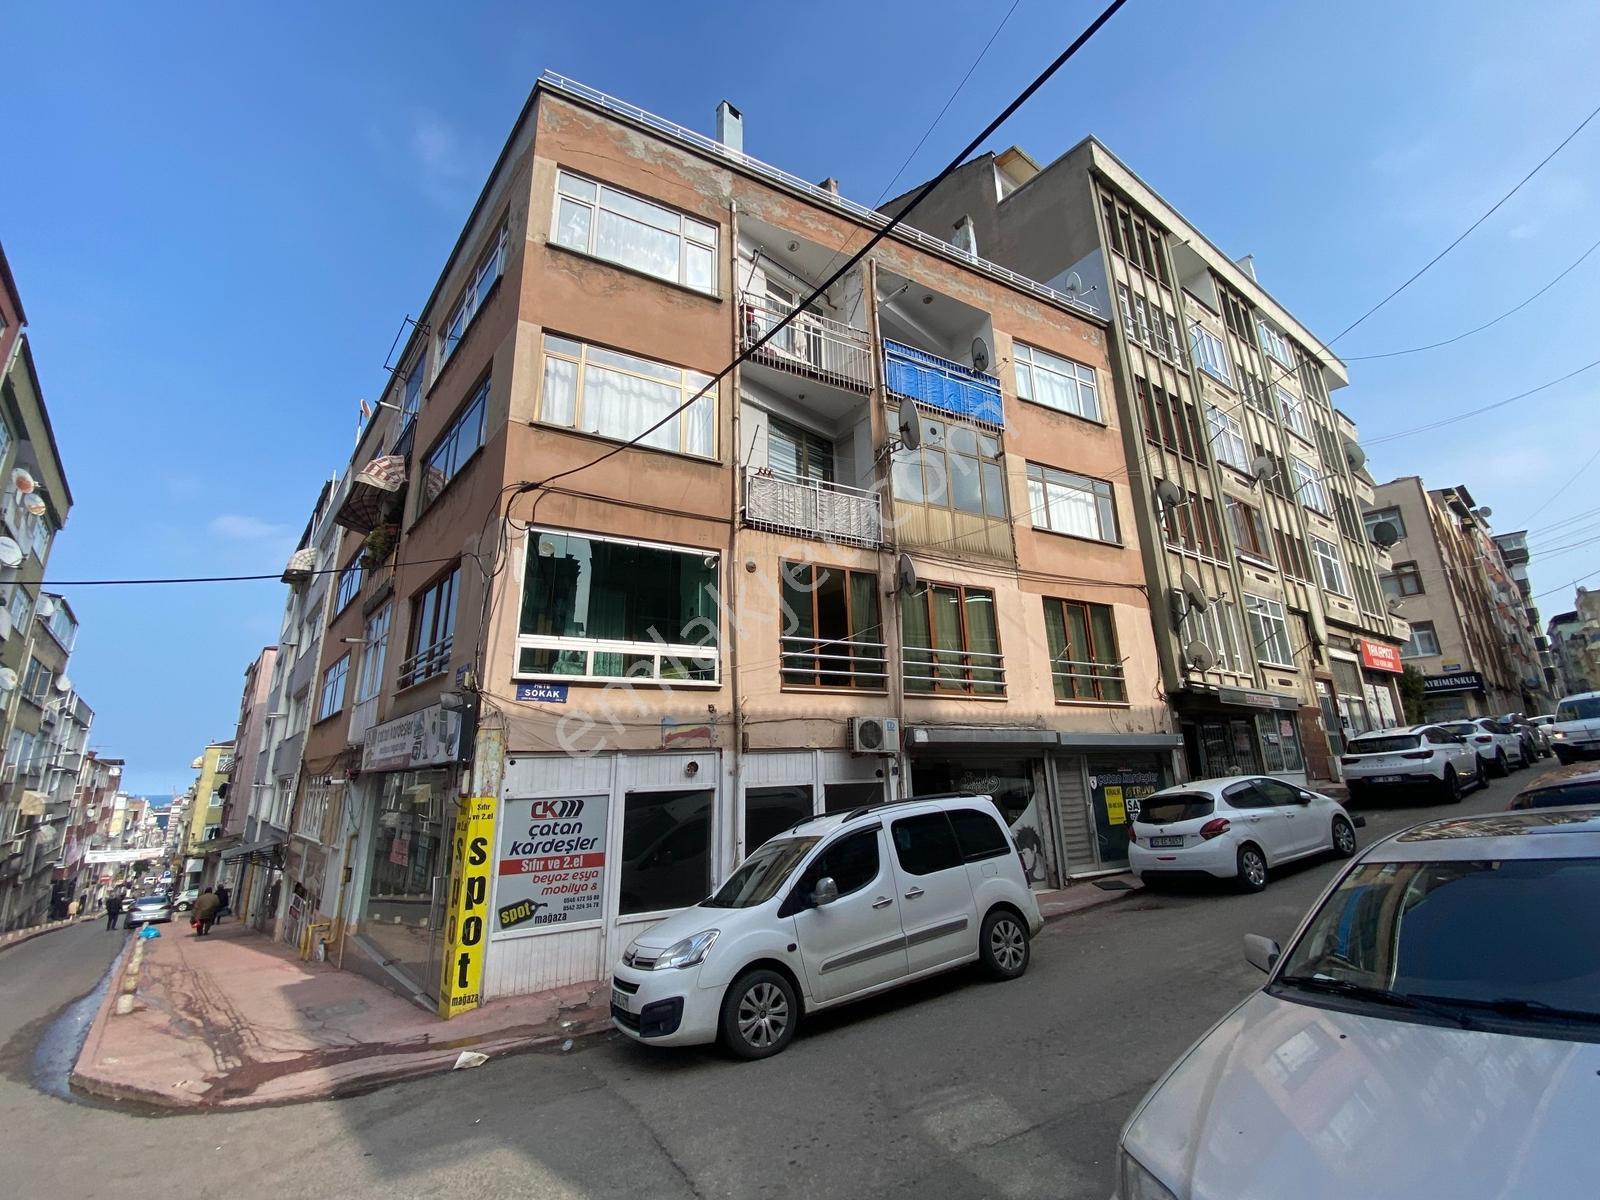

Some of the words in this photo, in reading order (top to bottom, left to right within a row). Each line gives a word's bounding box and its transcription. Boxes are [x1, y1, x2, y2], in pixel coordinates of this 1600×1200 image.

[1423, 675, 1477, 688] AYRIMENKUL
[525, 689, 560, 698] SOKAK
[529, 821, 583, 840] çatan
[509, 837, 598, 855] kardeşler
[521, 858, 545, 872] Sıfır
[547, 859, 561, 870] ve
[563, 855, 583, 868] 2.el
[532, 873, 569, 885] beyaz
[572, 870, 599, 882] eşya
[541, 882, 589, 896] mobilya
[590, 883, 598, 891] &
[458, 837, 488, 989] spot
[501, 902, 531, 924] spot
[534, 912, 567, 925] mağaza
[451, 993, 479, 1007] mağaza
